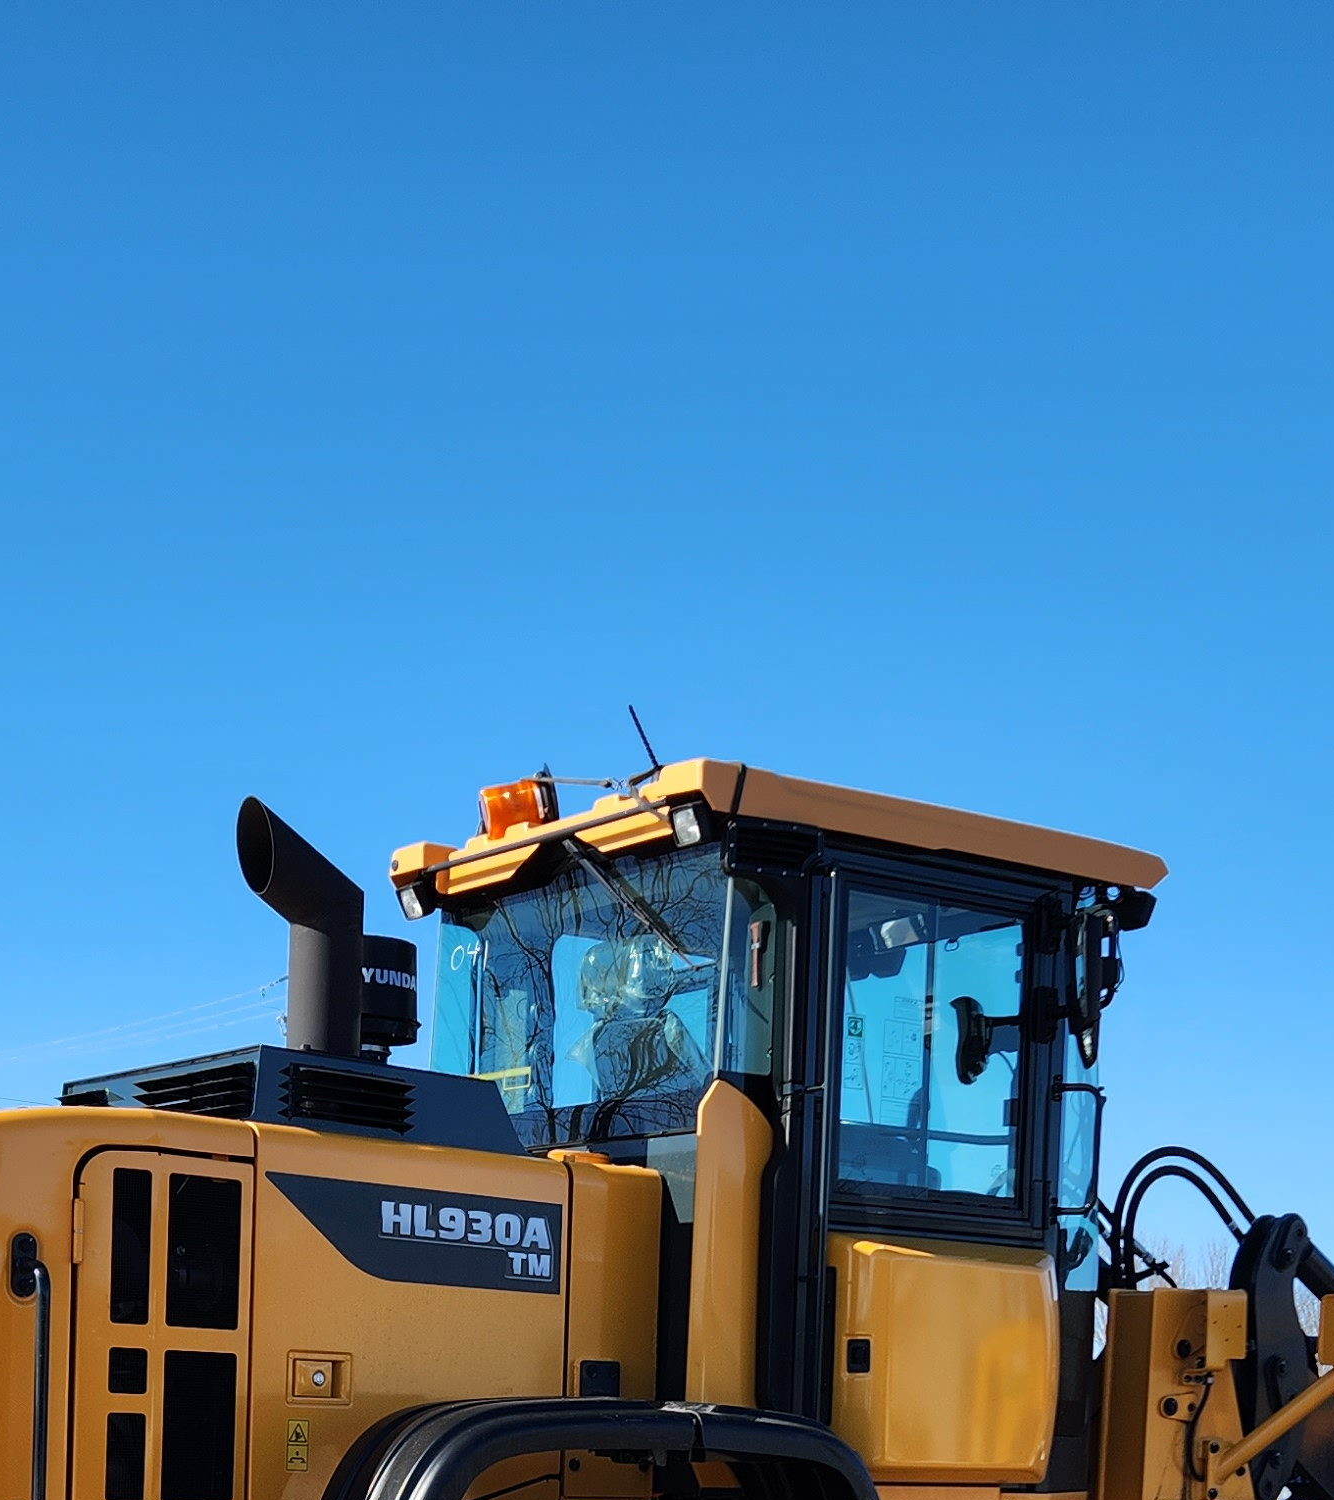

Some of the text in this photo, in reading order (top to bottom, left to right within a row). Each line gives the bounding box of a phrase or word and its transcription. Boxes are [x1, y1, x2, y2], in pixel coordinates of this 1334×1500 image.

[451, 940, 489, 971] 041
[362, 967, 417, 991] YUNDA
[381, 1200, 550, 1250] HL930A
[508, 1252, 551, 1277] TM
